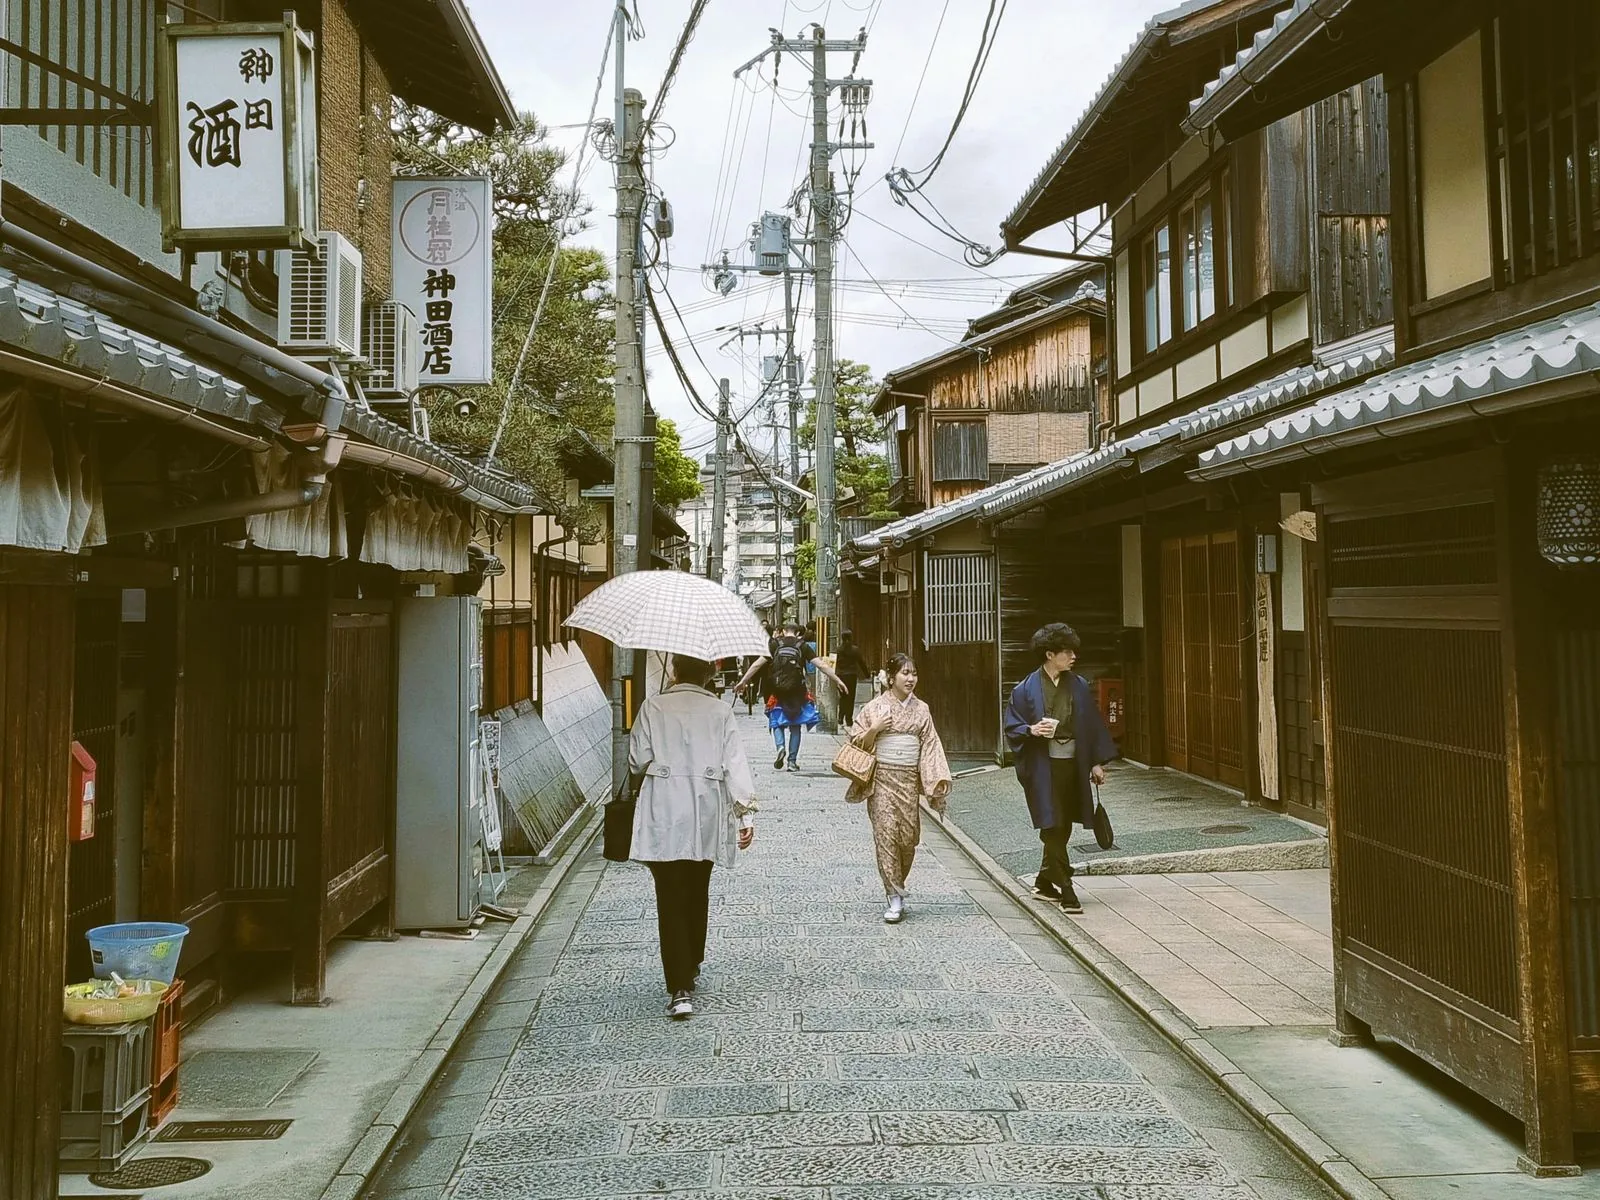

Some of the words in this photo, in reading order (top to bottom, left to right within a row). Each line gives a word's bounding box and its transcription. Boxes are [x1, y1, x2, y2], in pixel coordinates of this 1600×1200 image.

[186, 99, 242, 168] 酒
[425, 191, 452, 264] 月桂冠
[419, 268, 456, 375] 神田酒店
